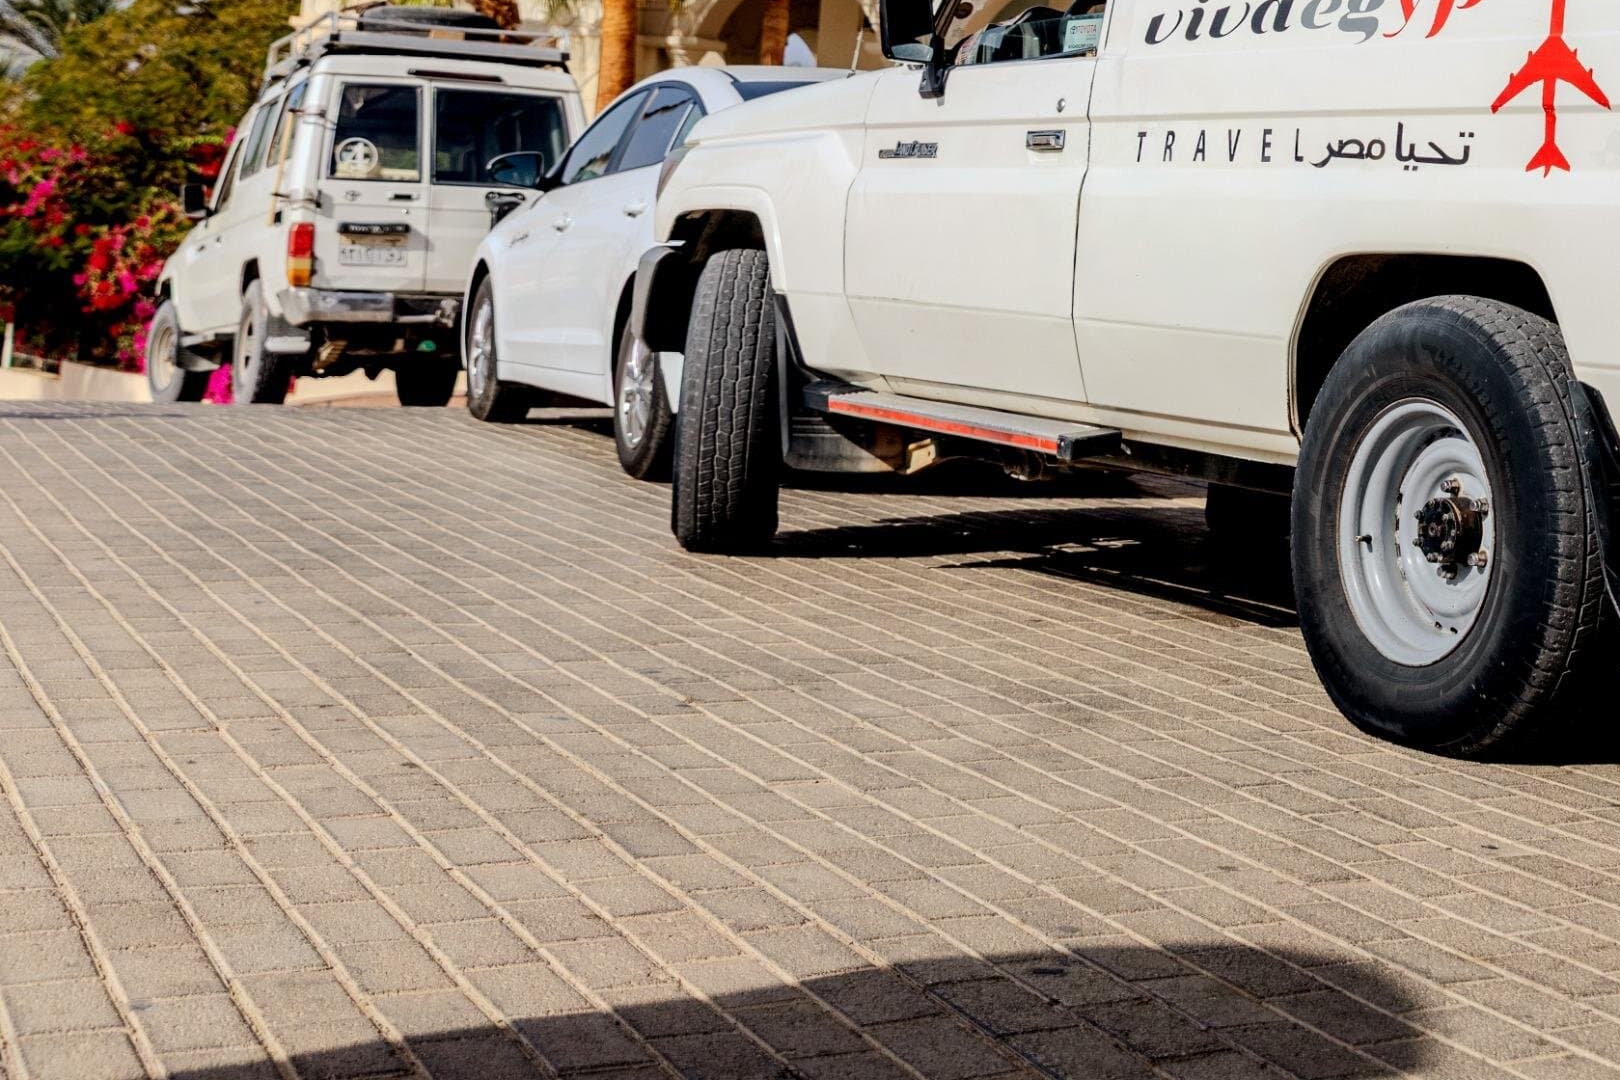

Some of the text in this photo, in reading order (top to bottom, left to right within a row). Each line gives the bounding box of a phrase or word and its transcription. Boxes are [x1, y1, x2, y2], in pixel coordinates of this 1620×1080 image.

[1136, 128, 1303, 163] TRAVEL
[1310, 122, 1475, 171] تحيا مصر
